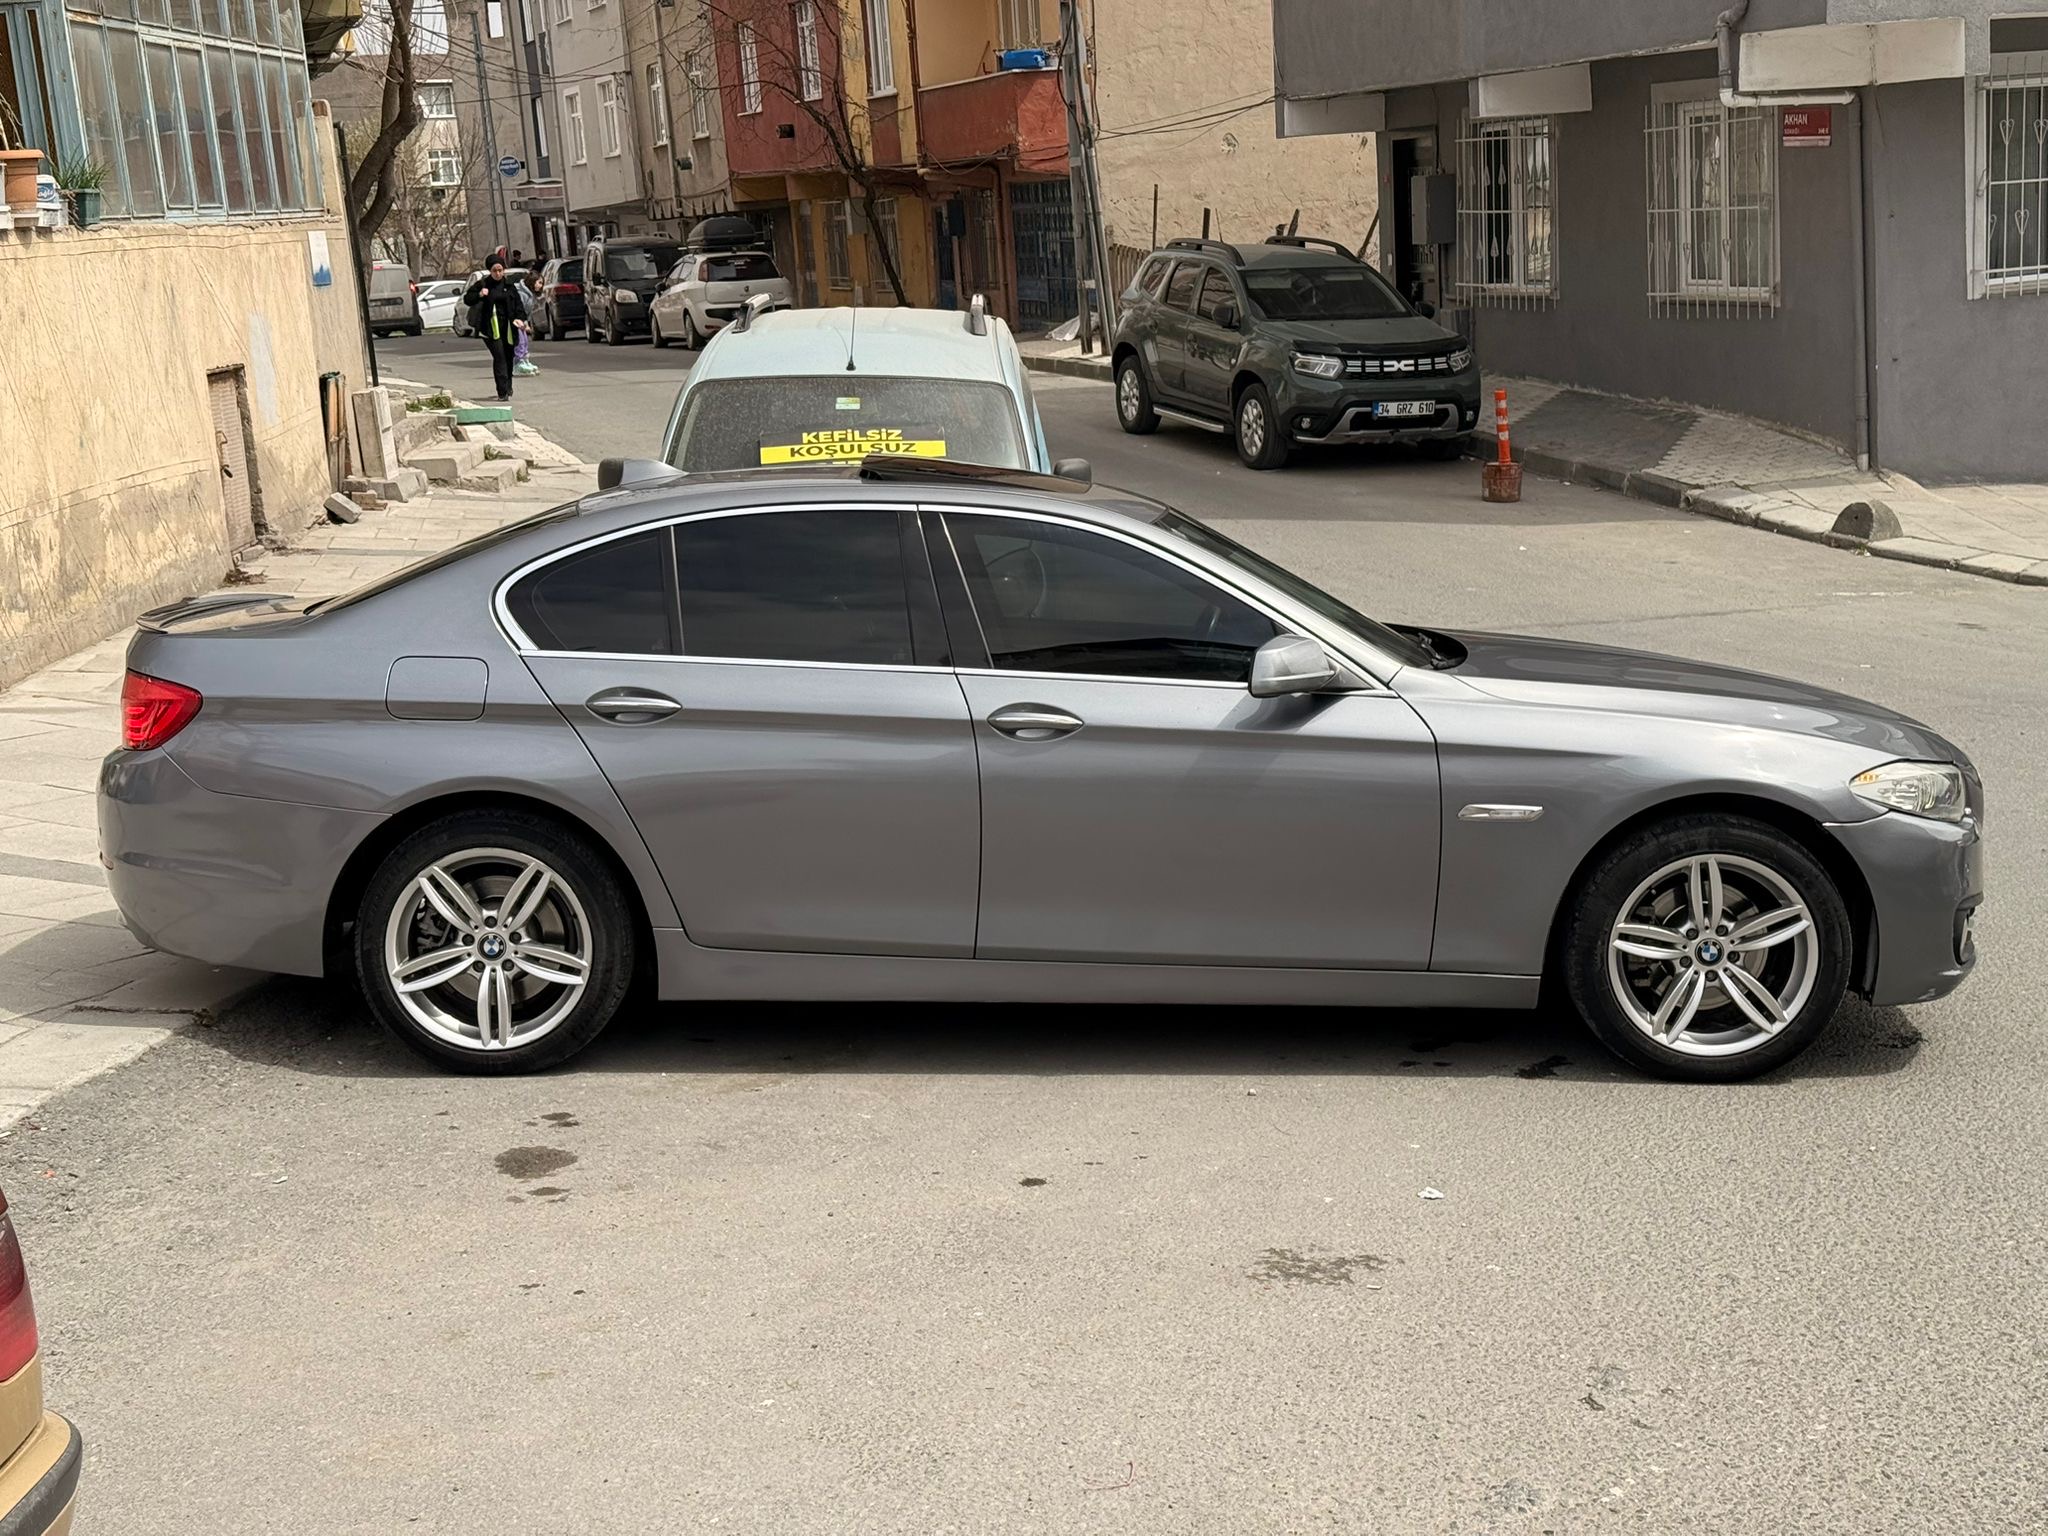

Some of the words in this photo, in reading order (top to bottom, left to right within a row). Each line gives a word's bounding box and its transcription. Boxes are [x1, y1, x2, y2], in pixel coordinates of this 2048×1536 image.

[1784, 113, 1808, 125] AKHAN
[1379, 403, 1390, 415] 34
[1396, 402, 1413, 415] GRZ
[1418, 402, 1434, 414] 610
[790, 442, 917, 458] KOŞULSUZ
